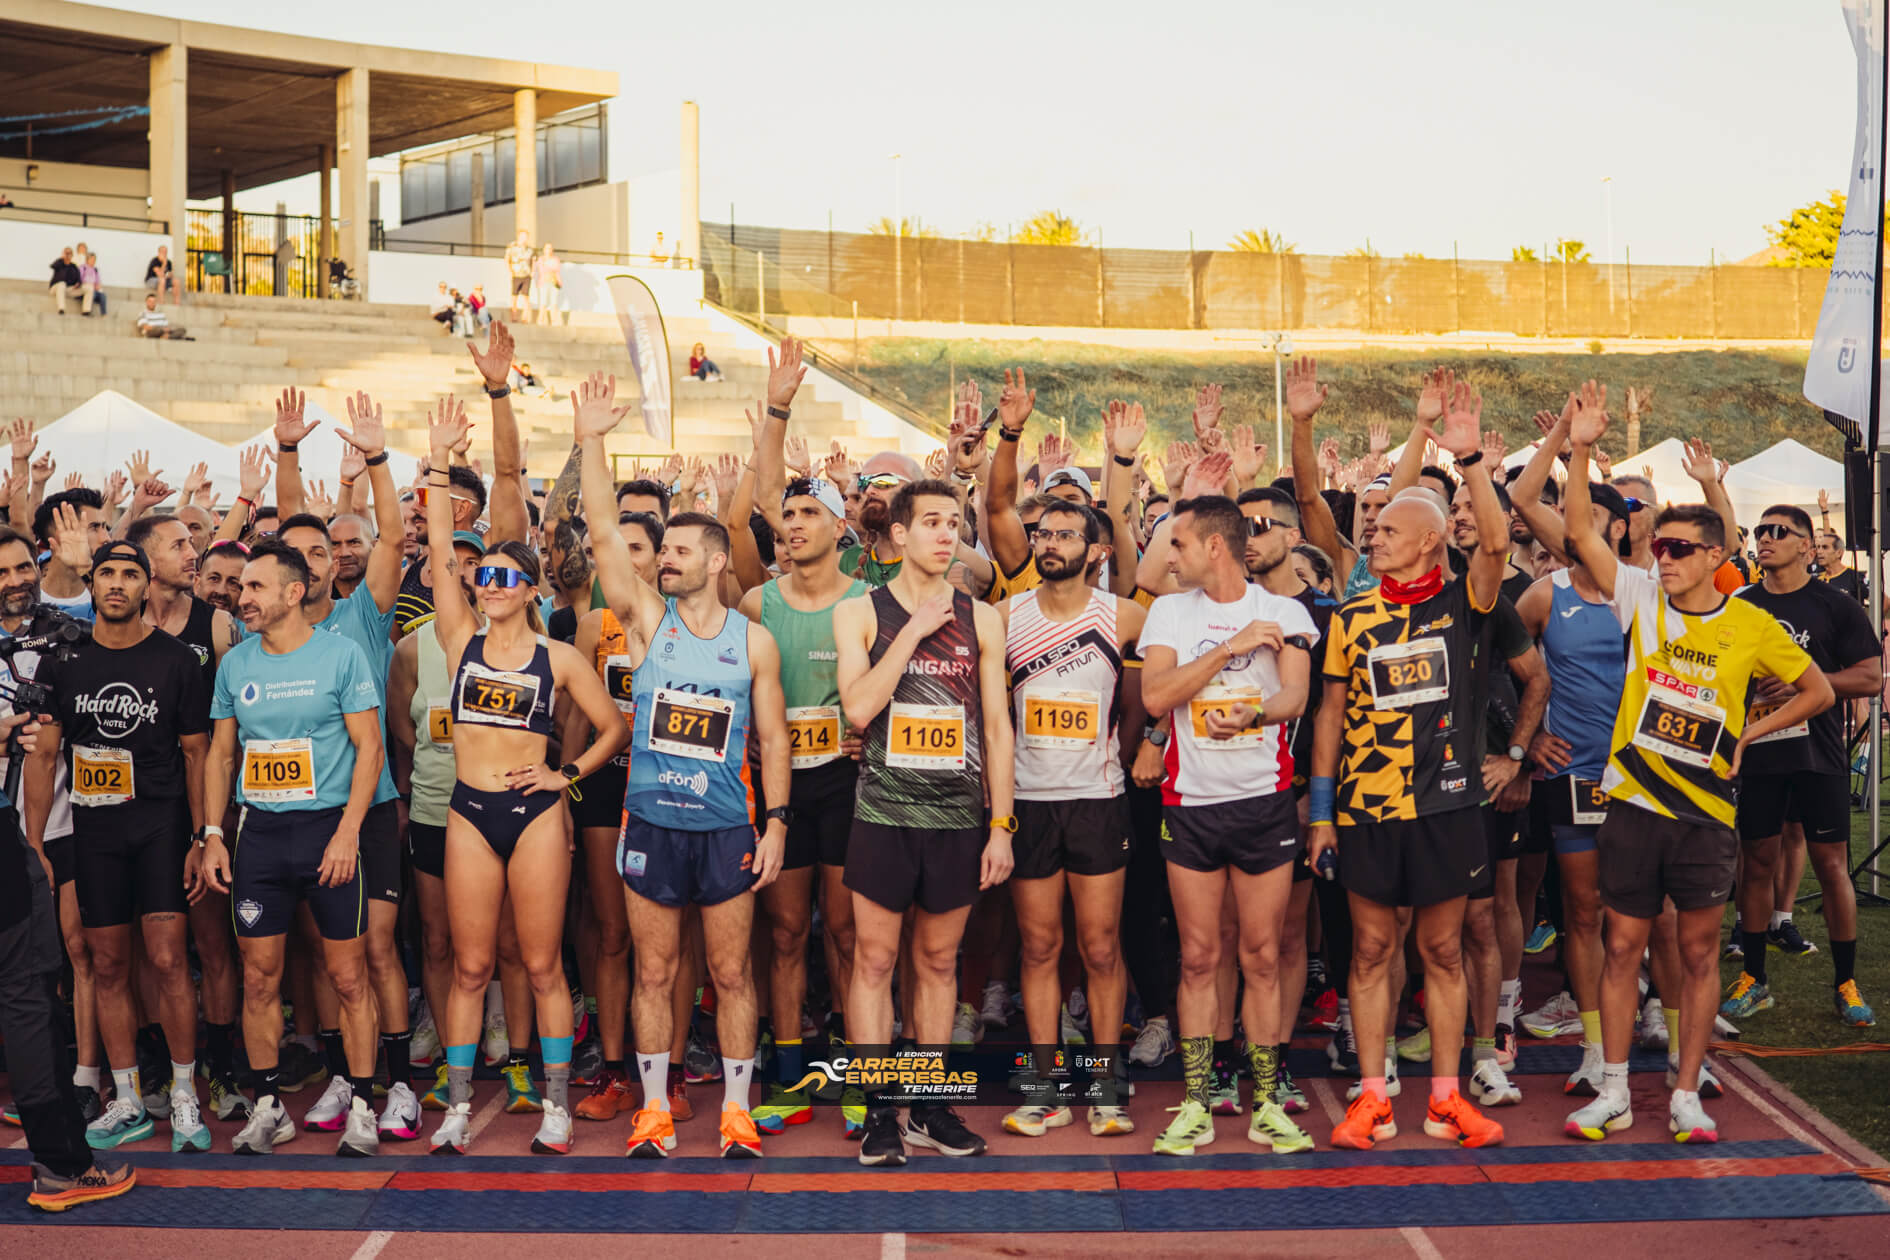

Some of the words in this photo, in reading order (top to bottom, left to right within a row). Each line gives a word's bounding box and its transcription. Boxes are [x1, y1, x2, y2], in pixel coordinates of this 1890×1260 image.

[22, 637, 48, 648] RONIN
[1664, 640, 1718, 668] CORRE
[1026, 656, 1047, 674] LA
[1047, 640, 1080, 663] SPO
[1388, 660, 1432, 686] 820
[1655, 672, 1697, 697] SPAR
[266, 688, 315, 700] Fernández
[476, 685, 517, 712] 751
[75, 694, 120, 714] Hard
[117, 694, 159, 724] Rock
[1034, 708, 1089, 730] 1196
[103, 719, 128, 729] HOTEL
[667, 712, 710, 739] 871
[1657, 712, 1700, 742] 631
[902, 726, 957, 748] 1105
[252, 760, 301, 781] 1109
[76, 1175, 107, 1187] HOKA
